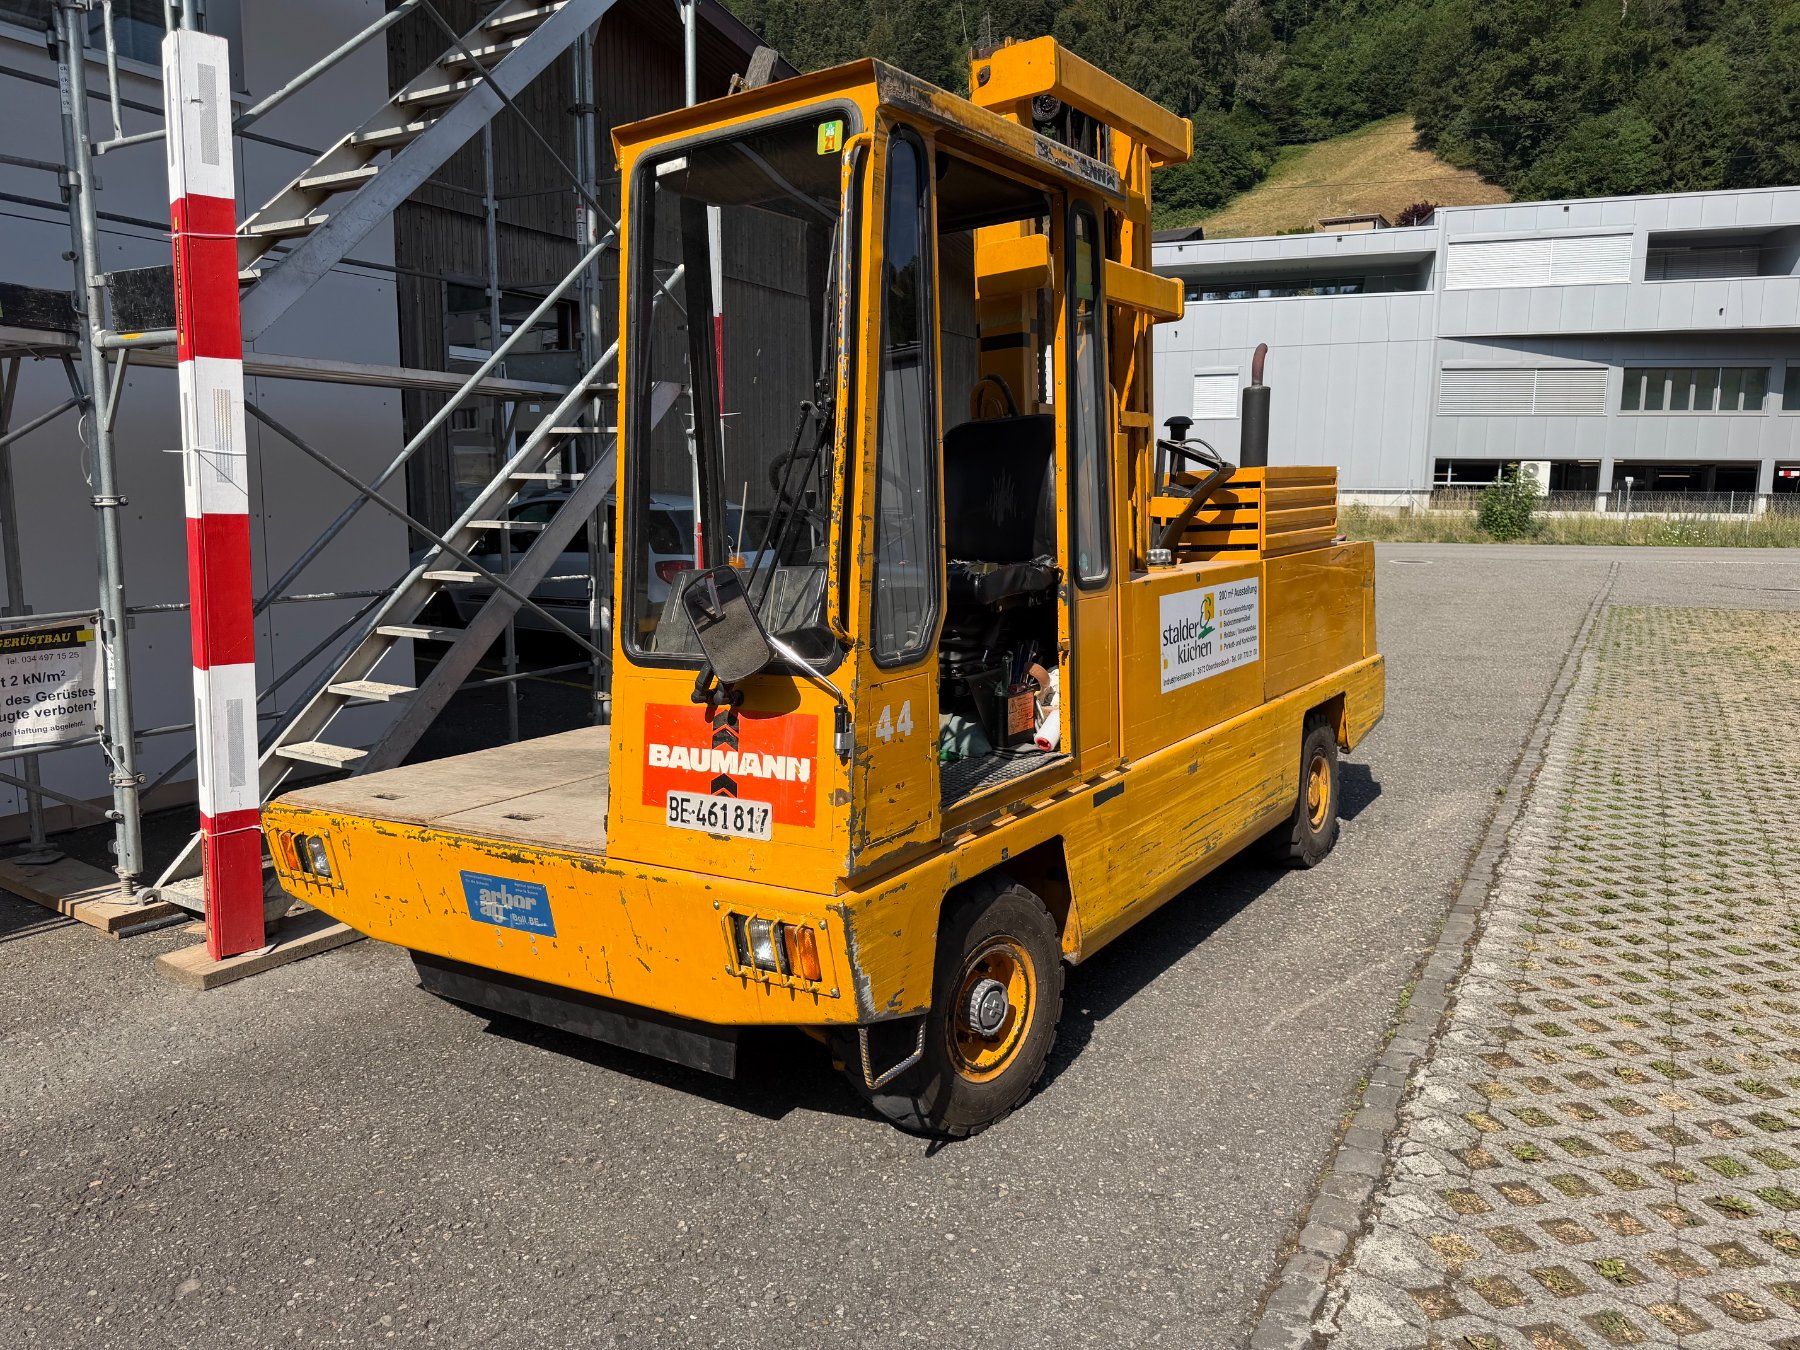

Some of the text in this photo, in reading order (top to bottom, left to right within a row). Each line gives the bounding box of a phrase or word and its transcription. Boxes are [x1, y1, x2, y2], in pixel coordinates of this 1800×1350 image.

[825, 136, 835, 150] 21
[1234, 585, 1258, 598] Ausstellung
[1163, 618, 1199, 646] stalder
[7, 651, 80, 665] Tel. 034 497 15 25
[1178, 640, 1212, 664] küchen
[10, 675, 18, 686] 2
[23, 670, 66, 684] kN/m²
[6, 688, 96, 706] des Gerüstes
[34, 700, 97, 718] verboten!
[876, 700, 914, 742] 44
[14, 725, 48, 736] Haftung
[648, 744, 810, 783] BAUMANN
[480, 884, 536, 910] arbor
[480, 900, 504, 924] ag
